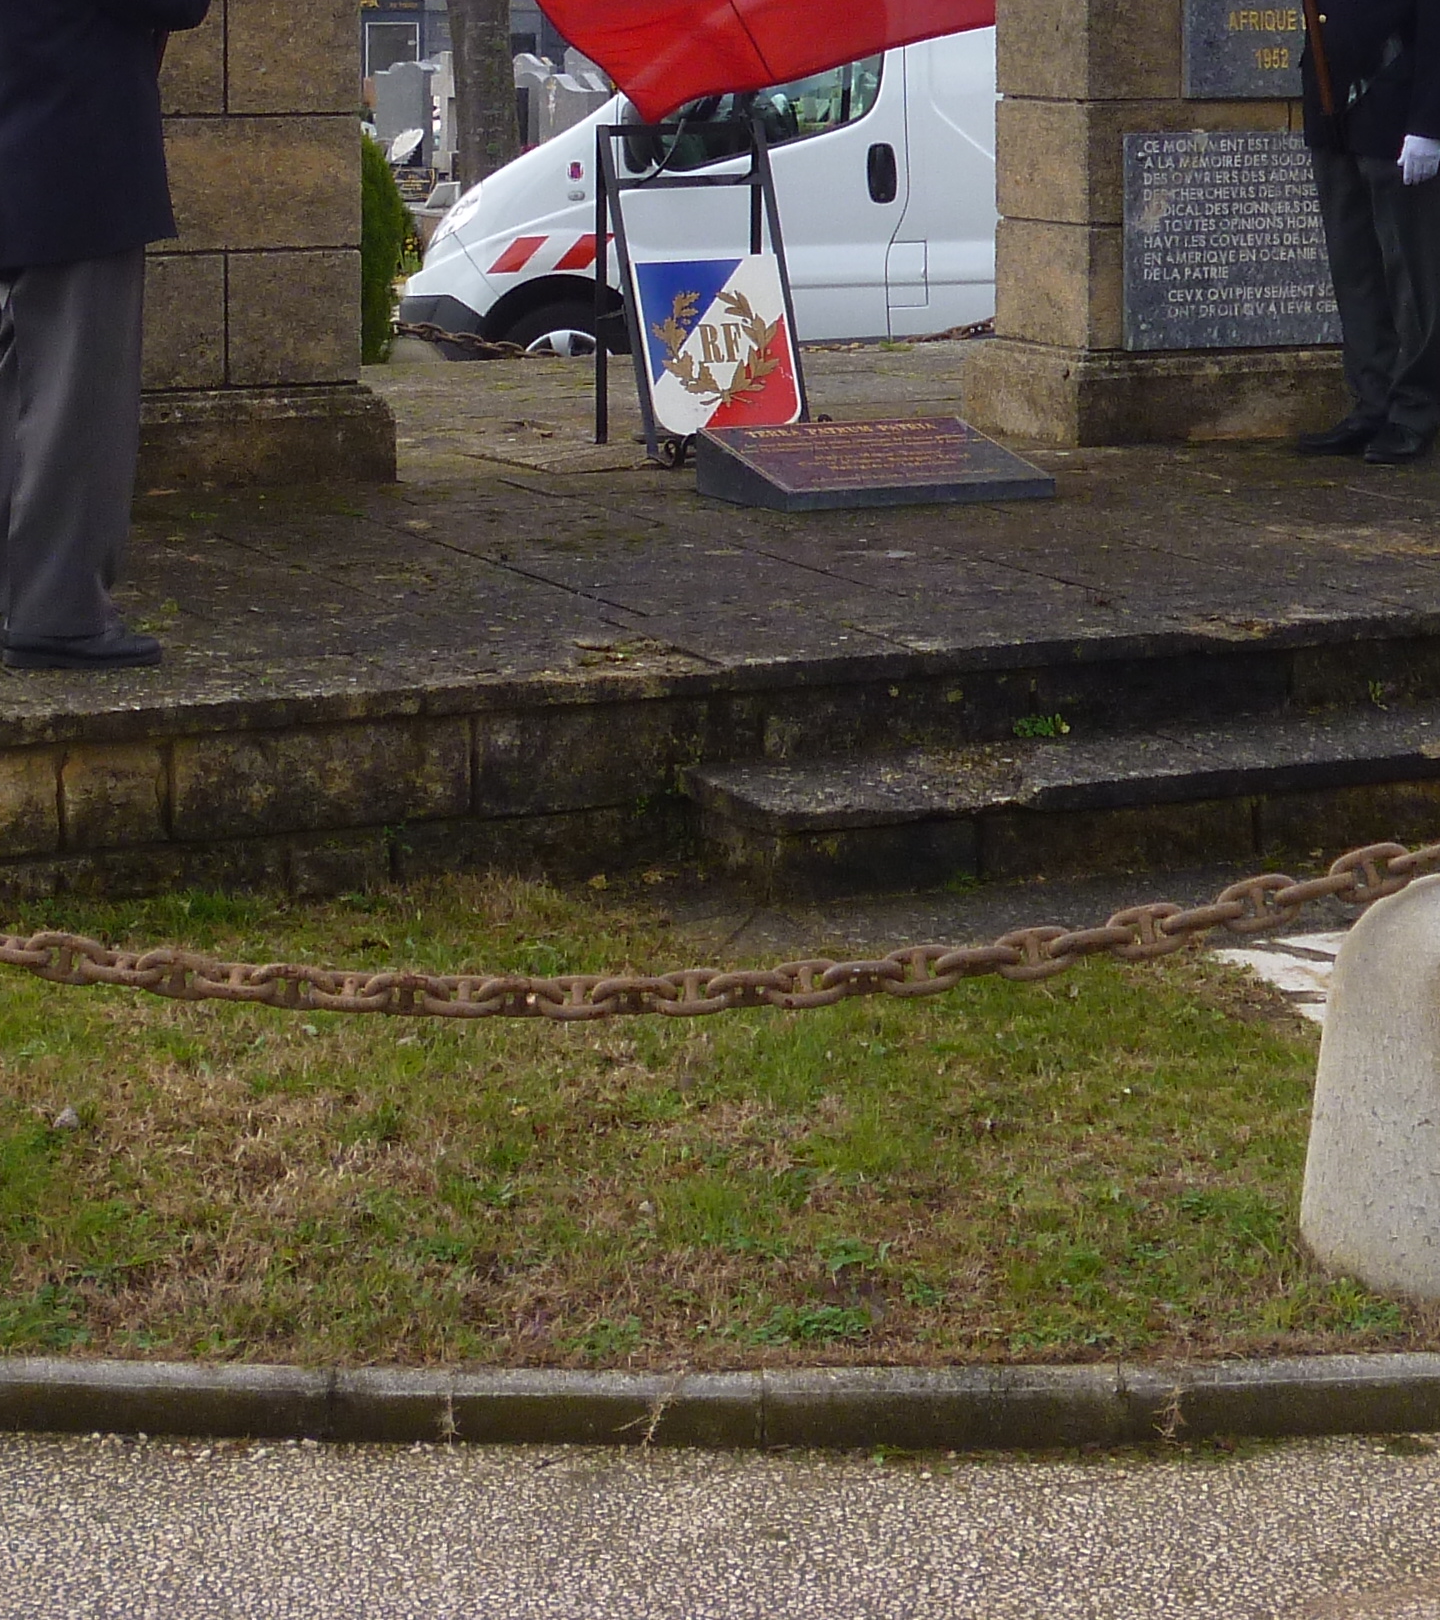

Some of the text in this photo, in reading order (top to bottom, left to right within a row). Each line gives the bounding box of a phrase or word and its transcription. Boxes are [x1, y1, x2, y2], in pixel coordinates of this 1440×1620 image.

[1228, 10, 1298, 31] AFRIQUE
[1255, 48, 1290, 69] 1952
[1144, 140, 1160, 153] CE
[1248, 137, 1269, 152] EST
[1144, 156, 1154, 169] A
[1158, 156, 1175, 169] LA
[1179, 154, 1241, 169] MEMOIRE
[1244, 153, 1269, 167] DES
[1143, 172, 1168, 186] DES
[1241, 169, 1266, 183] DES
[1205, 202, 1229, 216] DES
[1232, 200, 1301, 216] PIONNIERS
[1303, 200, 1320, 213] DE
[1164, 217, 1215, 232] TOVTES
[1219, 216, 1284, 231] OPINIONS
[1184, 234, 1206, 248] LES
[1210, 232, 1280, 247] COVLEVRS
[1283, 232, 1300, 246] DE
[1302, 231, 1319, 245] LA
[1144, 251, 1162, 266] EN
[1166, 249, 1236, 265] AMERIQVE
[1239, 248, 1256, 262] EN
[1260, 247, 1317, 262] OCEANIE
[1144, 266, 1229, 281] DE LA PATRIE
[698, 321, 743, 364] RF
